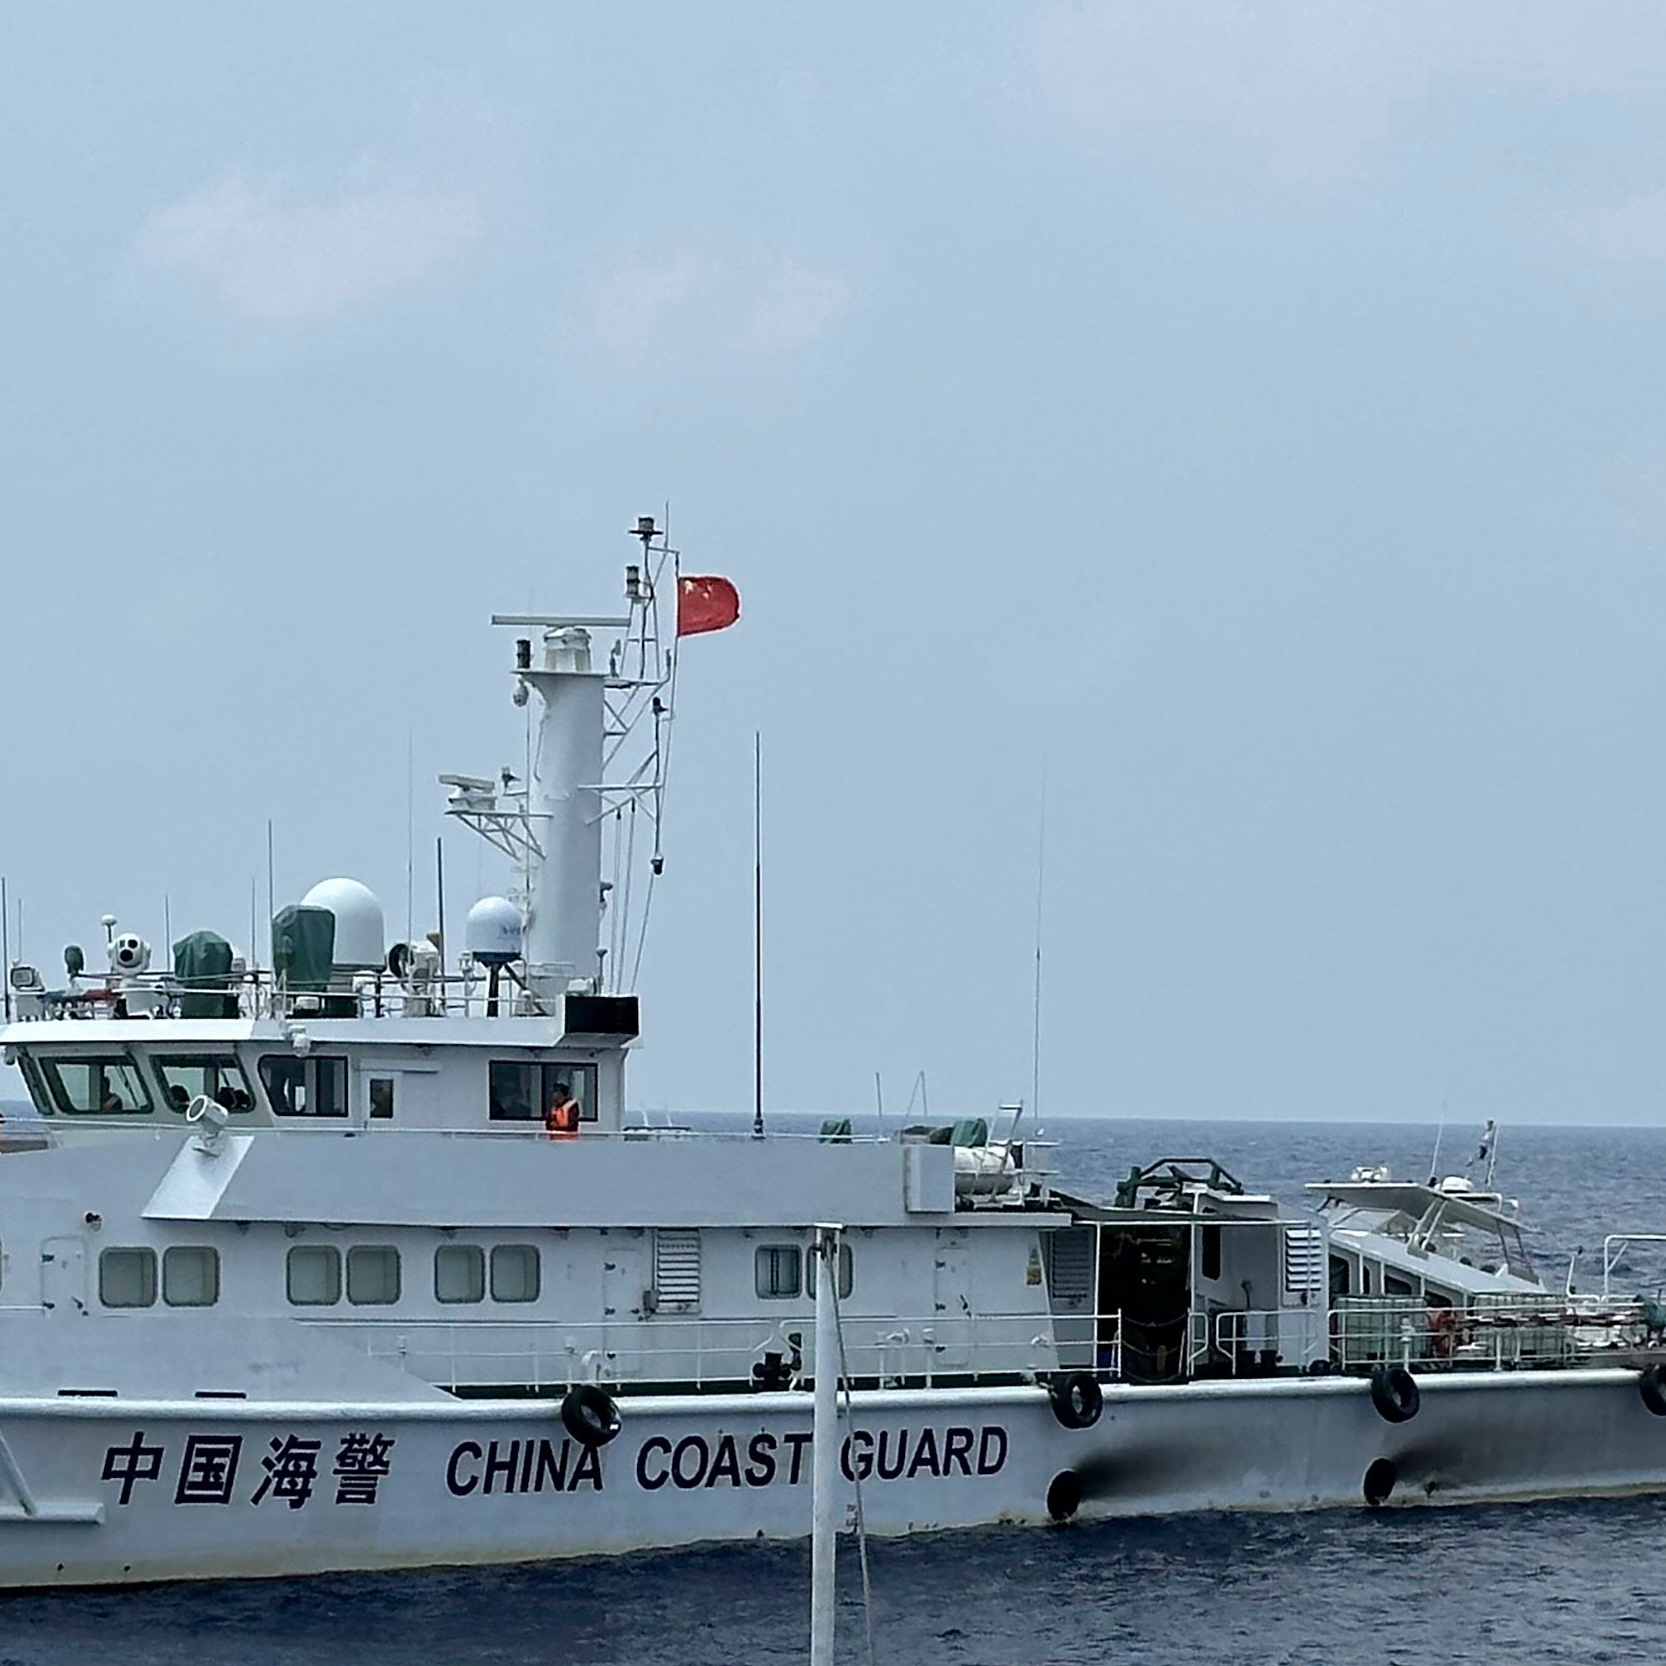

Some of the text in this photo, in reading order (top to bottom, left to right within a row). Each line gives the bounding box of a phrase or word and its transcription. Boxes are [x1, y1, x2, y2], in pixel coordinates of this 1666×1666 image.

[100, 1431, 396, 1510] 中国海警
[446, 1426, 1008, 1497] CHINA COAST GUARD
